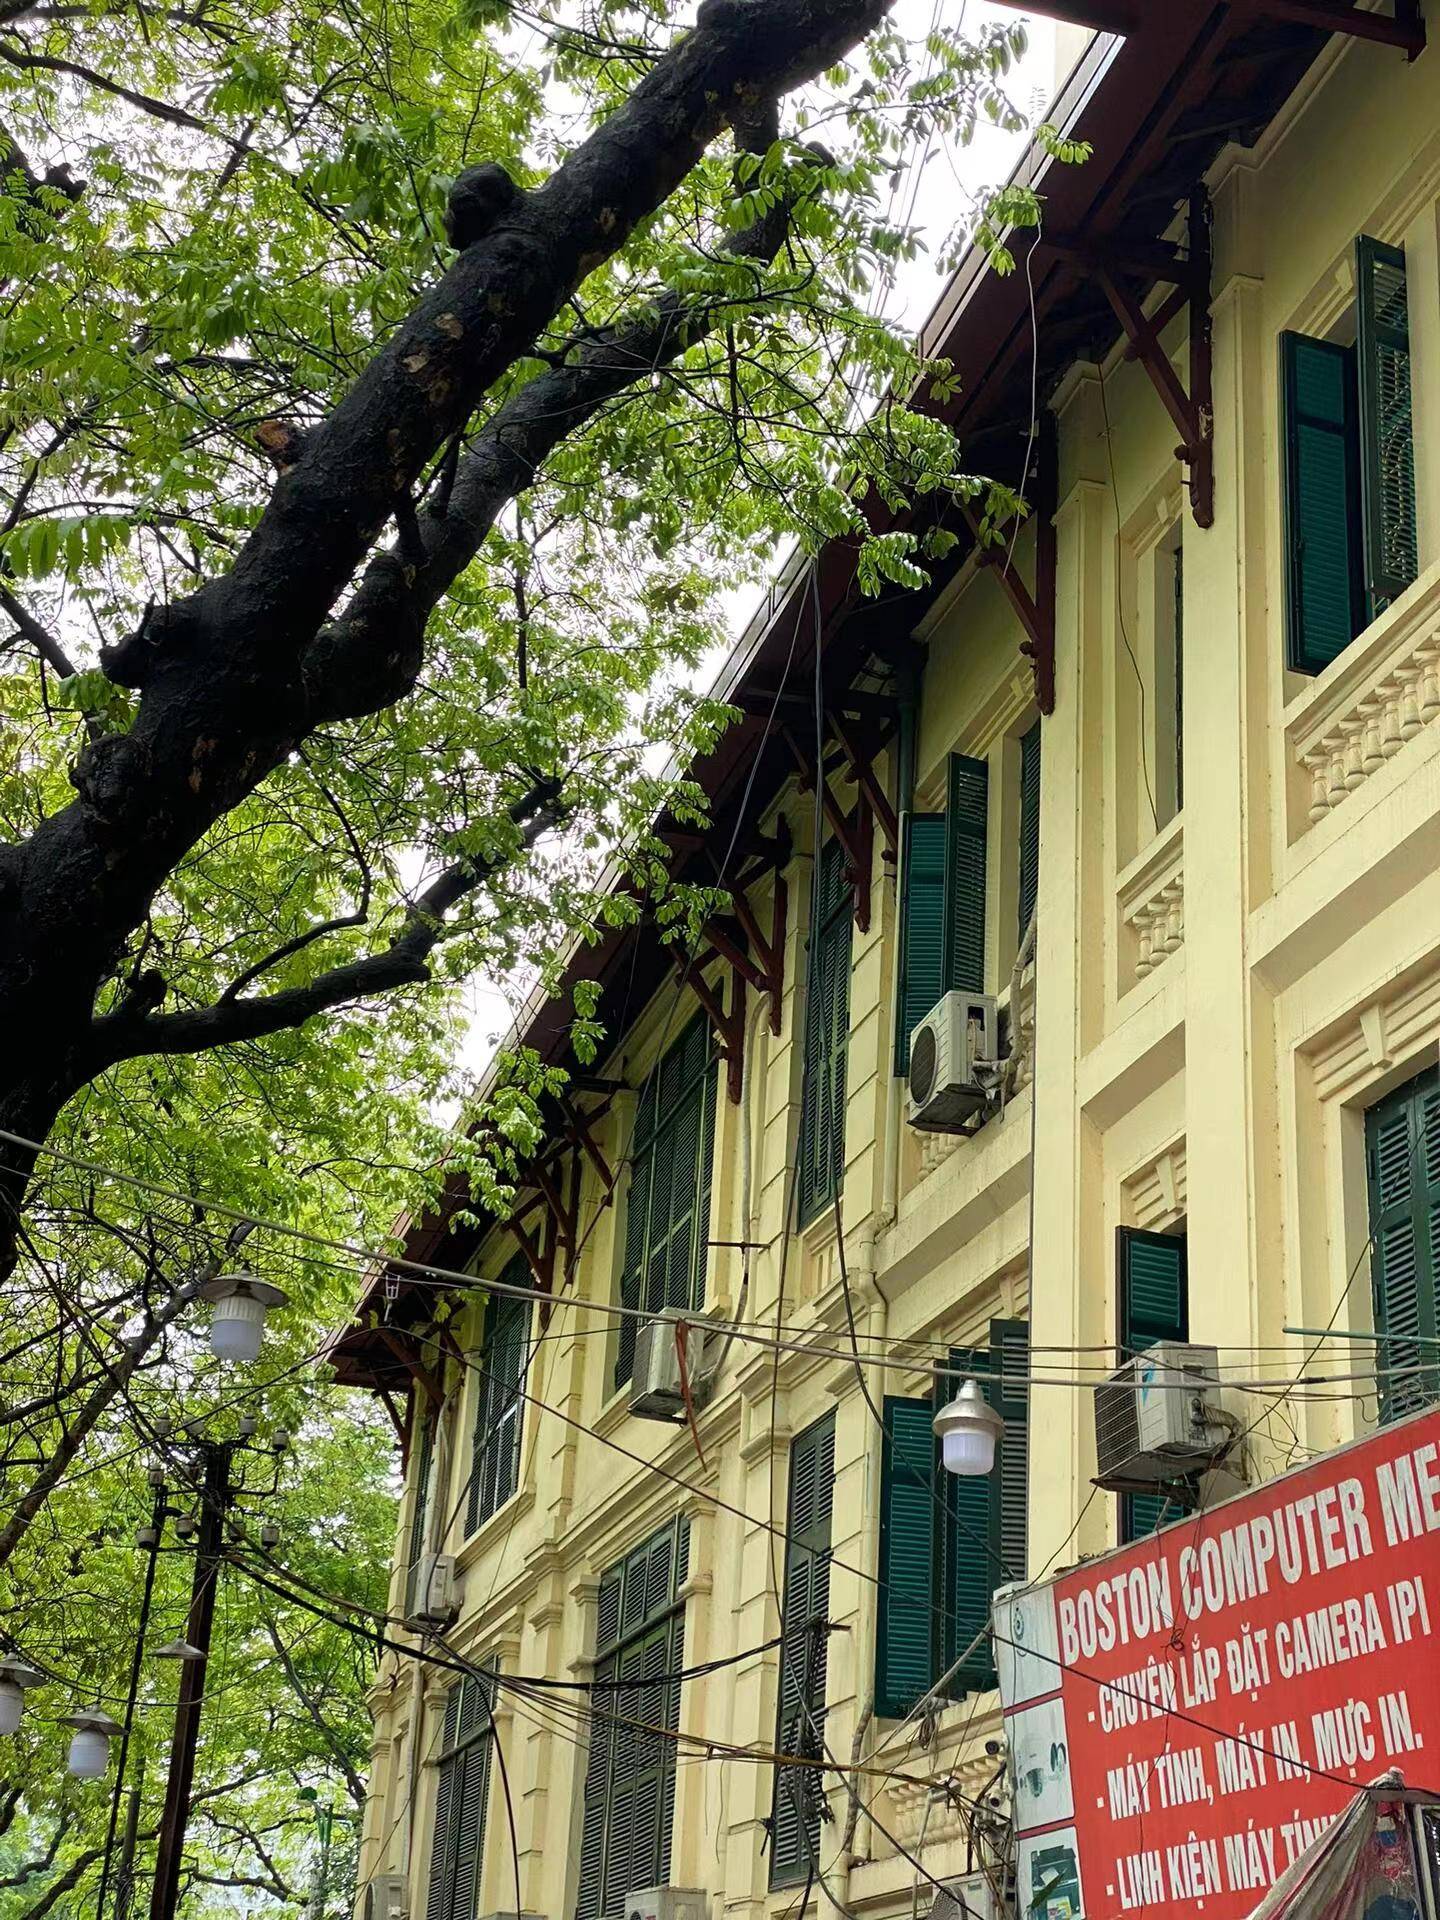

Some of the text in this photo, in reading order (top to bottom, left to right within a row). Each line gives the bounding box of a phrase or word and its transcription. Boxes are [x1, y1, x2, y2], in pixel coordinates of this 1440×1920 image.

[1059, 1440, 1440, 1666] BOSTON COMPUTER ME
[1099, 1655, 1178, 1733] CHUYÊN
[1179, 1633, 1221, 1709] LẮP
[1225, 1622, 1271, 1702] ĐẶT
[1275, 1592, 1387, 1679] CAMERA
[1107, 1690, 1424, 1821] MÁY TÍNH, MÁY IN, MỰC IN.
[1116, 1850, 1166, 1910] LINH
[1166, 1831, 1223, 1910] KIỆN
[1223, 1819, 1278, 1892] MÁY
